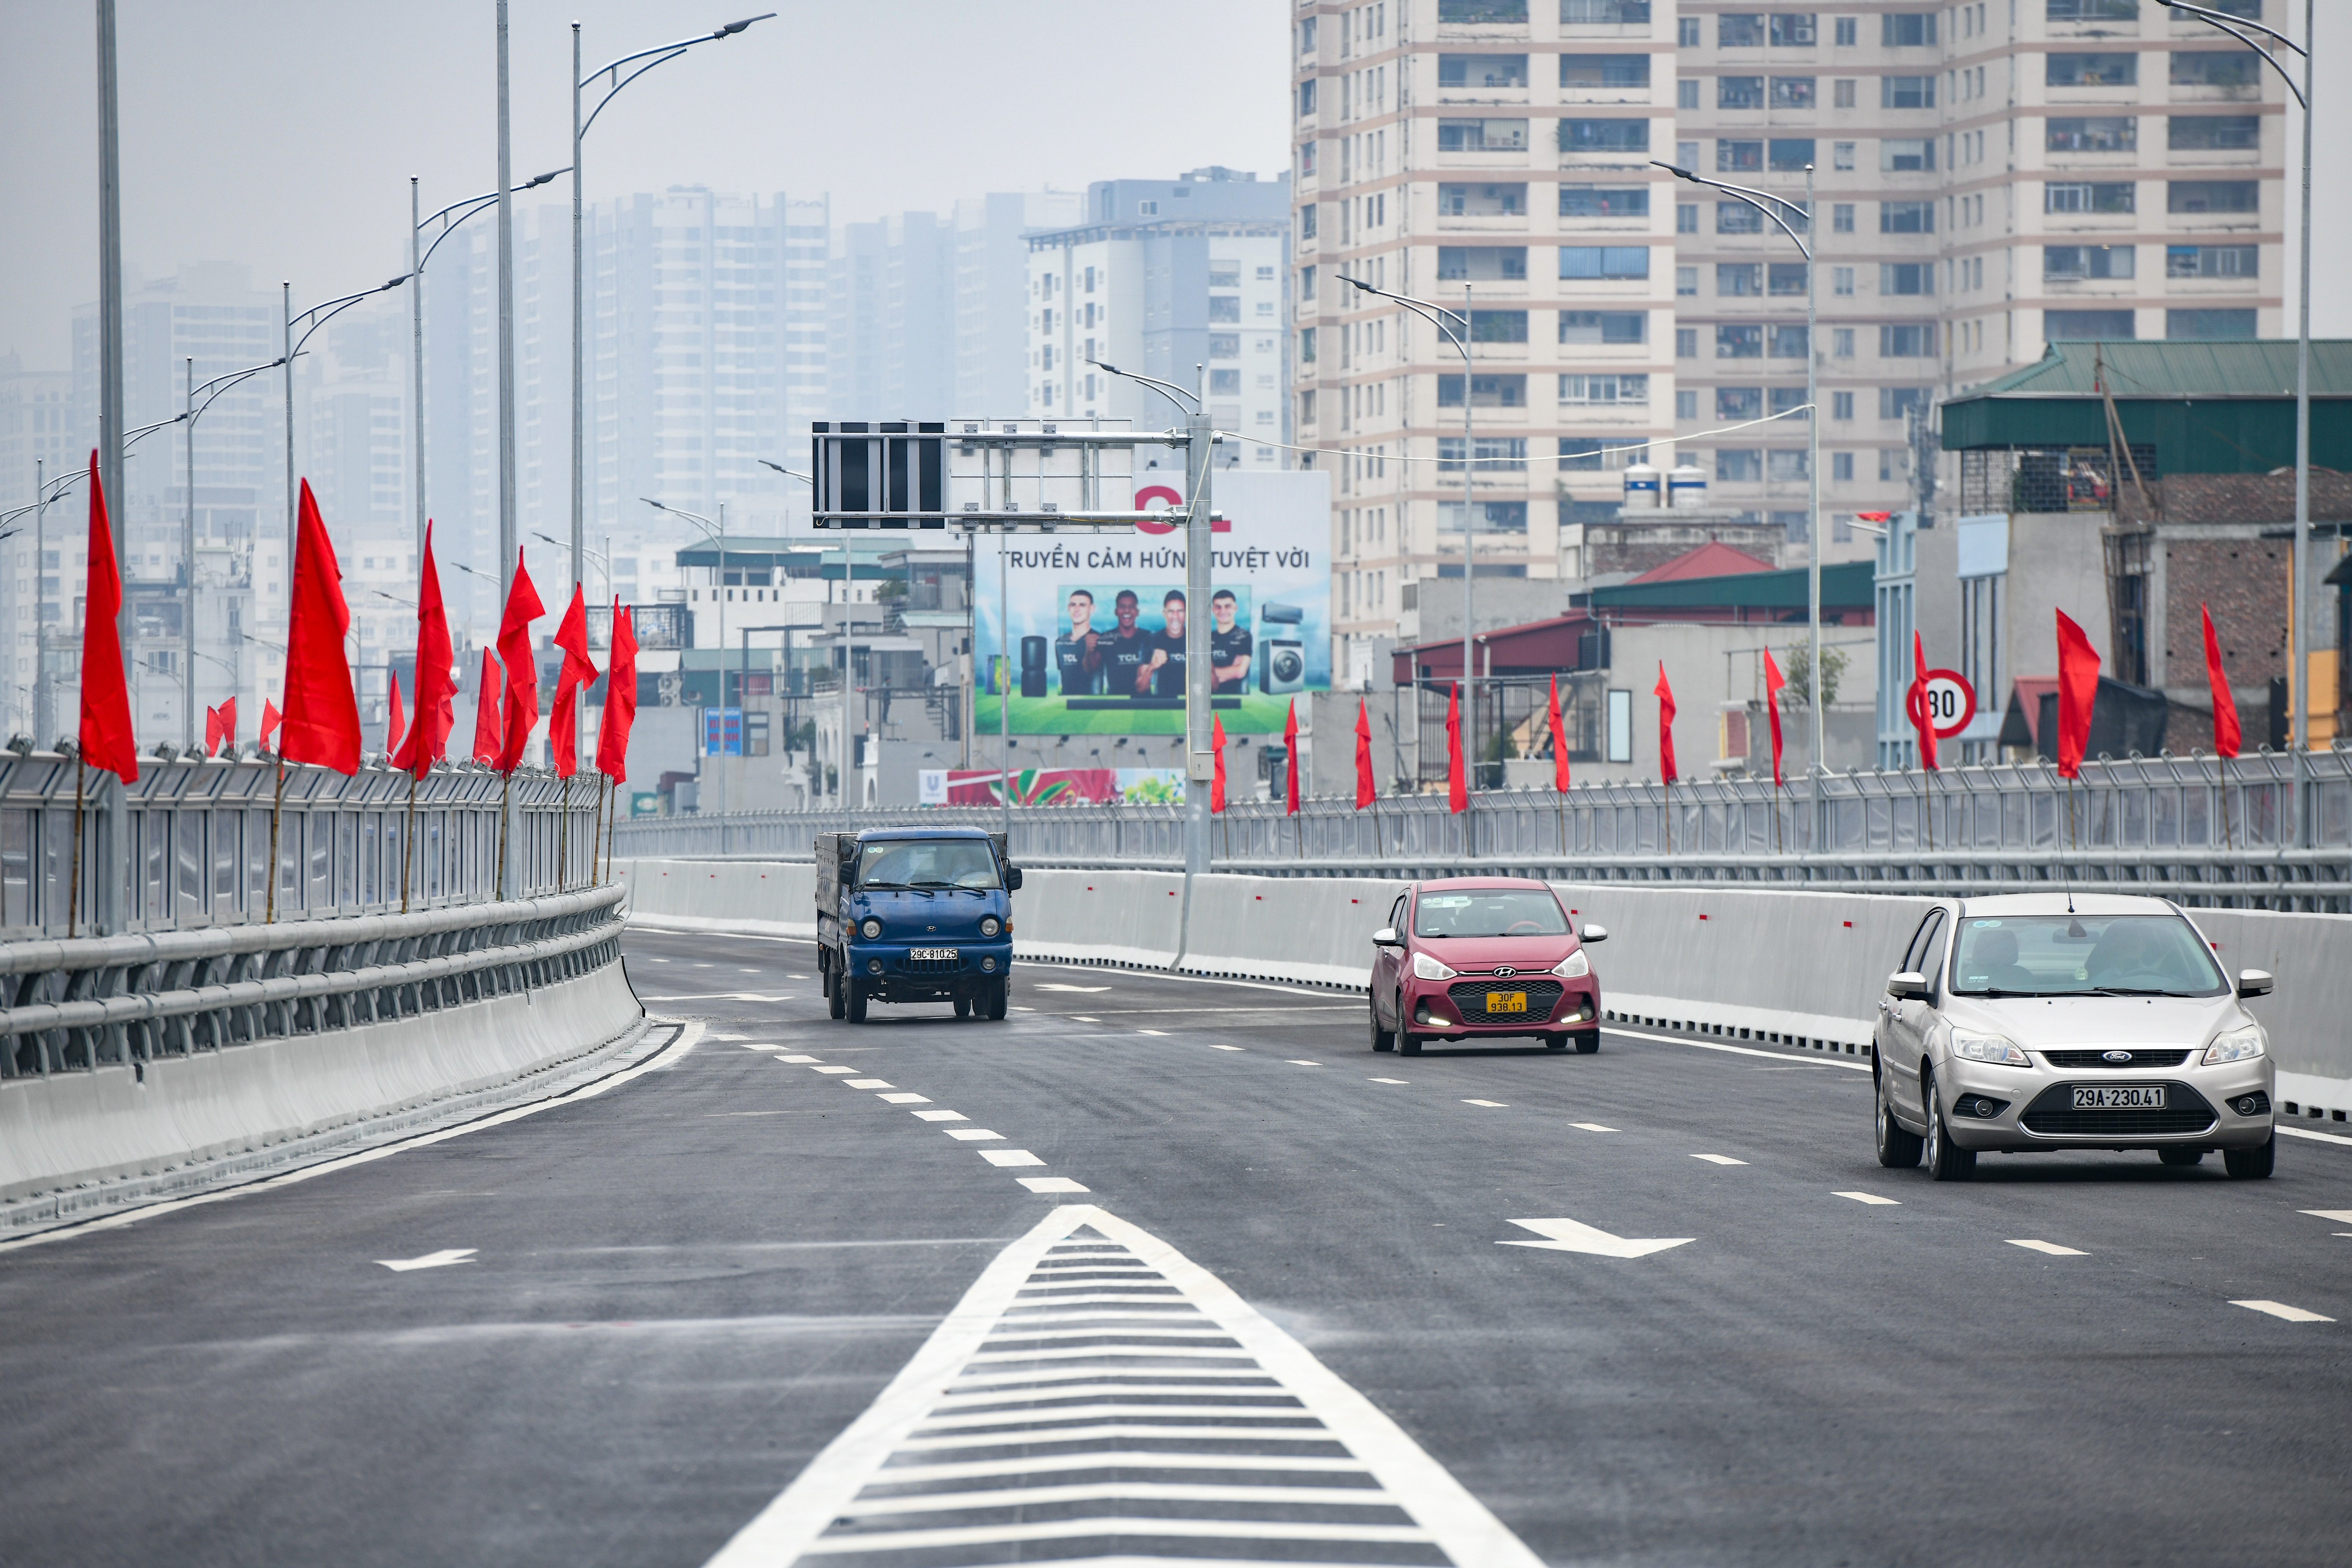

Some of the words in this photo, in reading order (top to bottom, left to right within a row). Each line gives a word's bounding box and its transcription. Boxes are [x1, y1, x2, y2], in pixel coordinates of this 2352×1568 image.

[998, 543, 1079, 568] RUYỀN
[1088, 546, 1132, 568] CẢM
[1140, 546, 1185, 568] HỨN
[1211, 546, 1269, 573] TUYỆT
[1276, 547, 1309, 568] VỜI
[912, 950, 956, 958] 29C-810.25
[1498, 993, 1515, 1002] 30F
[1491, 1002, 1522, 1011] 938.13
[2076, 1089, 2161, 1106] 29A-230.41
